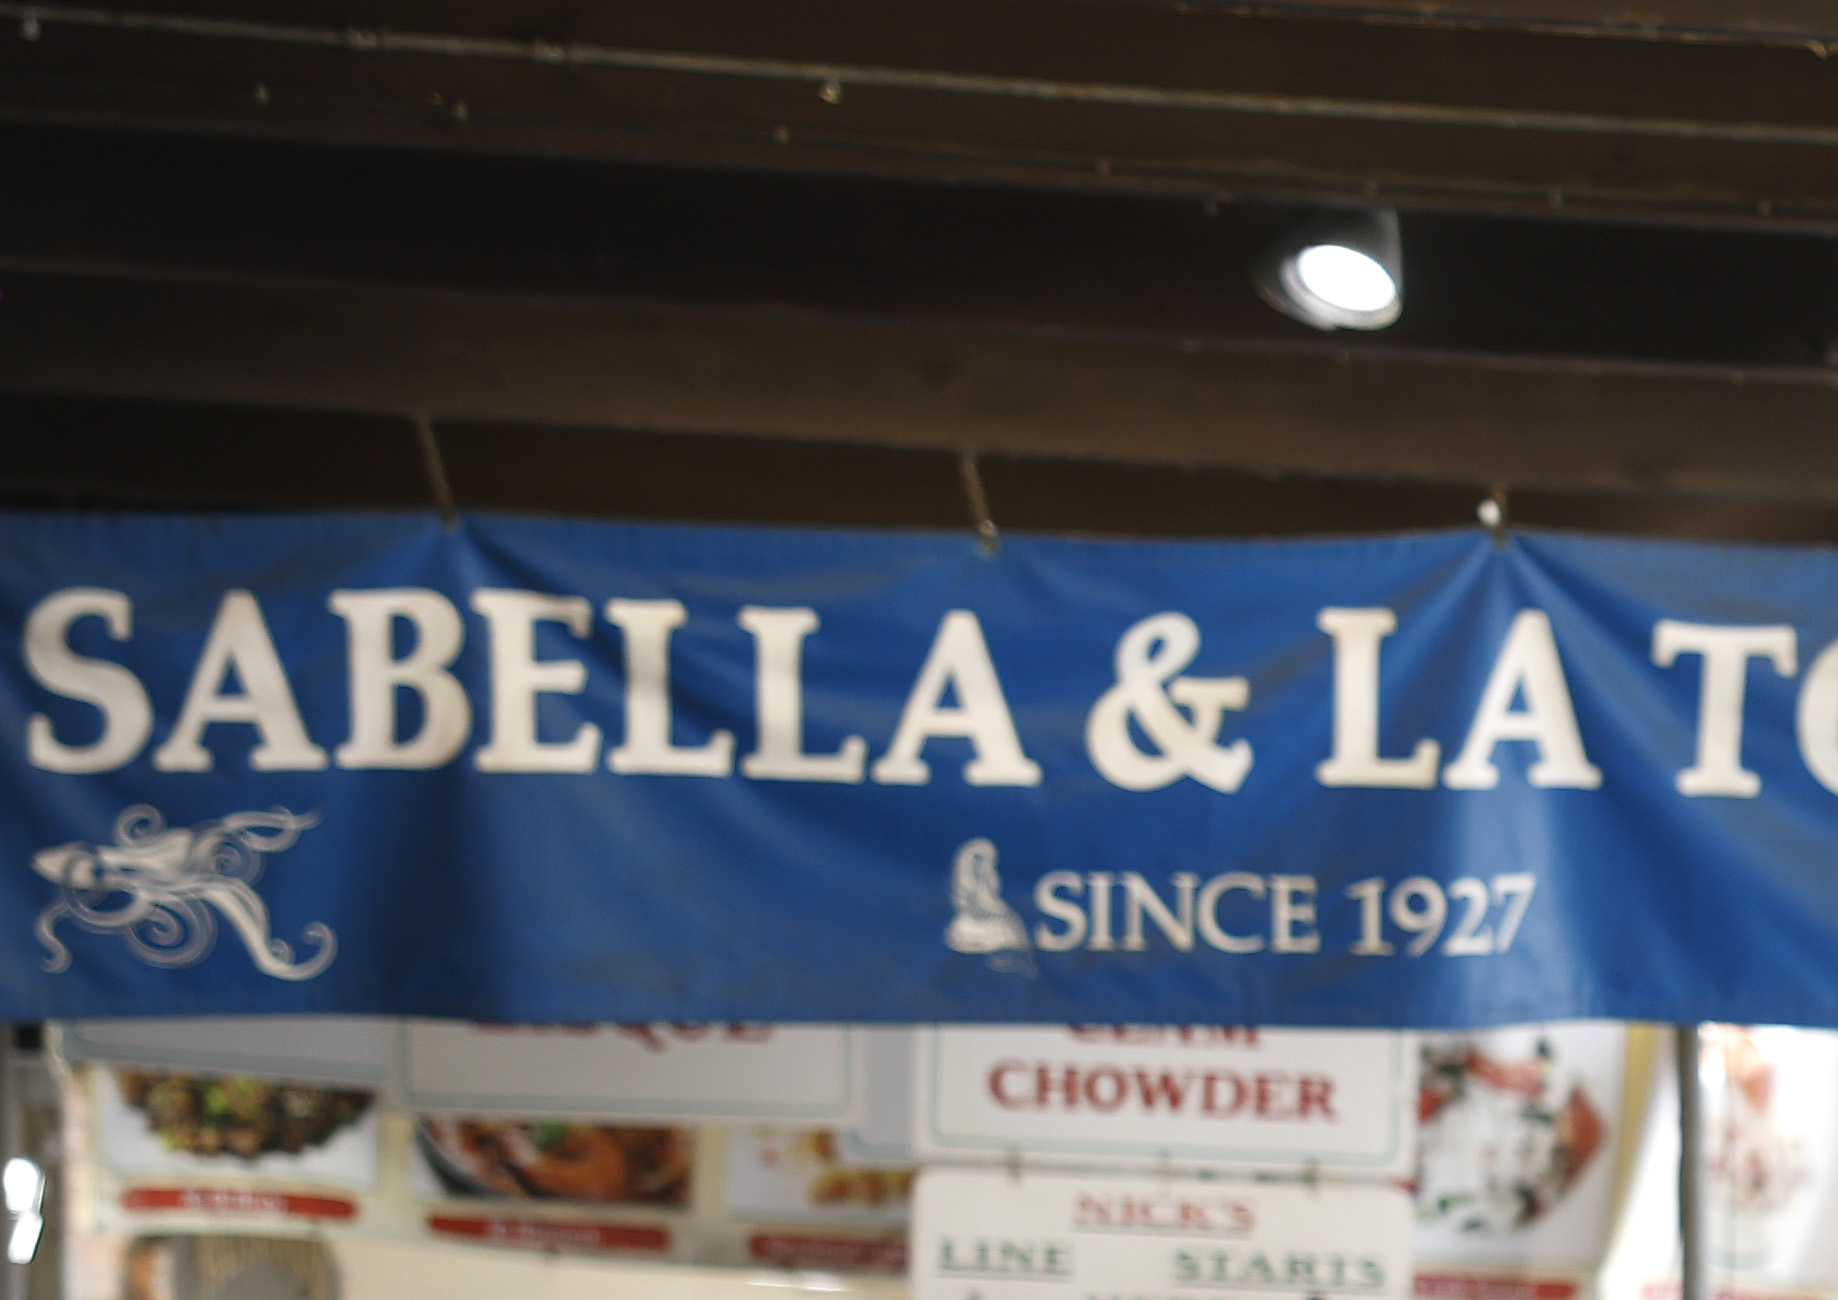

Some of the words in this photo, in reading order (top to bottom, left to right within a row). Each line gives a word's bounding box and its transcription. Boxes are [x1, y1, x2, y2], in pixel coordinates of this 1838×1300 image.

[20, 587, 1042, 786] SABELLA
[1087, 612, 1253, 792] &
[1315, 607, 1602, 790] LA
[1033, 869, 1319, 957] SINCE
[1346, 872, 1537, 957] 1927
[987, 1058, 1340, 1123] CHOWDER
[1073, 1193, 1257, 1235] NICK'S
[937, 1237, 1073, 1279] LINE
[1172, 1247, 1387, 1292] STARTS
